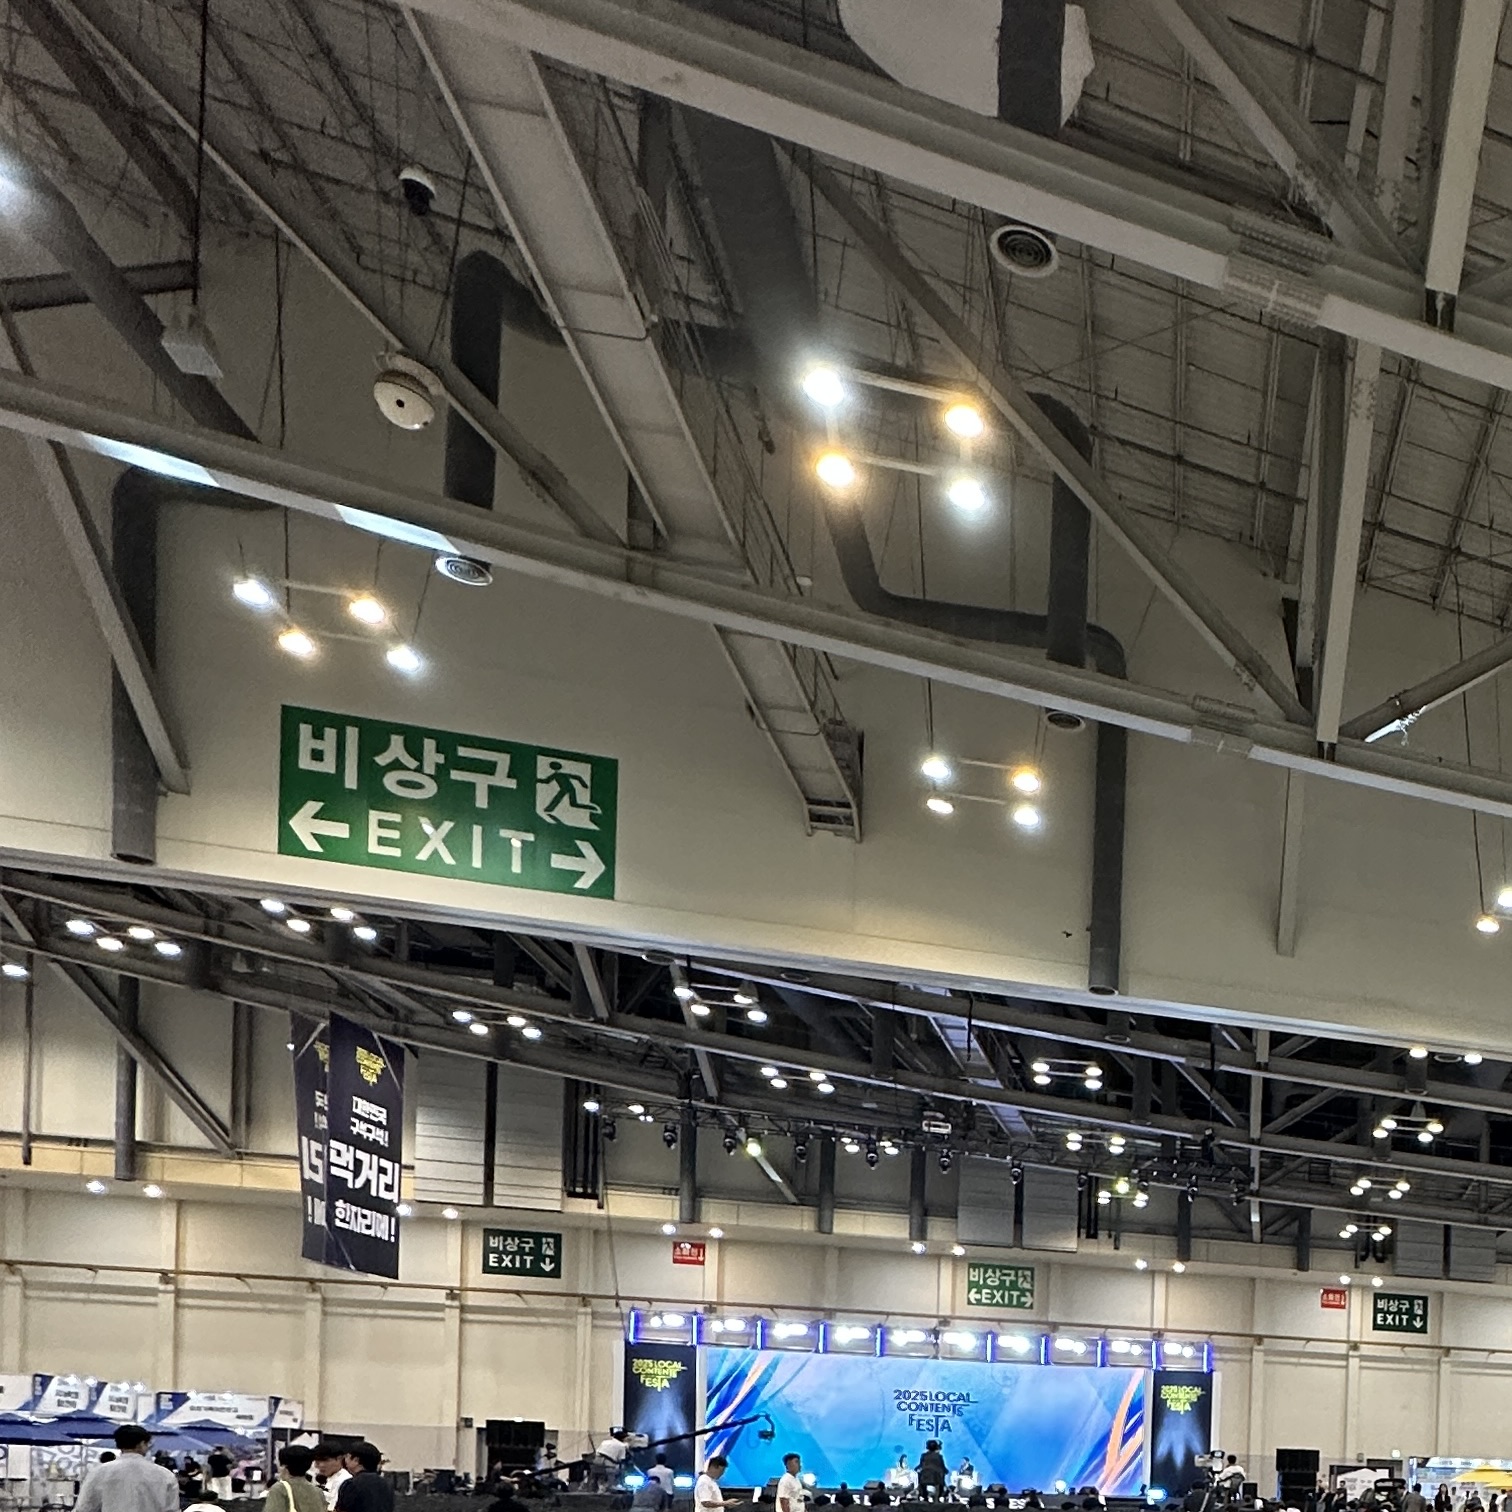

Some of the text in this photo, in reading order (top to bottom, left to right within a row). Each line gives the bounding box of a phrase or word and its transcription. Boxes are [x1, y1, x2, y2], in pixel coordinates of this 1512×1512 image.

[298, 723, 517, 808] 비상구
[367, 809, 535, 874] EXIT
[329, 1138, 399, 1203] 먹거리
[334, 1199, 396, 1243] 한자리에!
[489, 1236, 535, 1253] 비상구
[488, 1253, 534, 1269] EXIT
[969, 1268, 1016, 1287] 비상구
[981, 1289, 1020, 1305] EXIT
[1377, 1299, 1410, 1312] 비상구
[1377, 1313, 1409, 1326] EXIT
[893, 1389, 978, 1403] 2025 LOCAL
[896, 1401, 970, 1416] CONTENTS
[908, 1414, 952, 1437] FESTA
